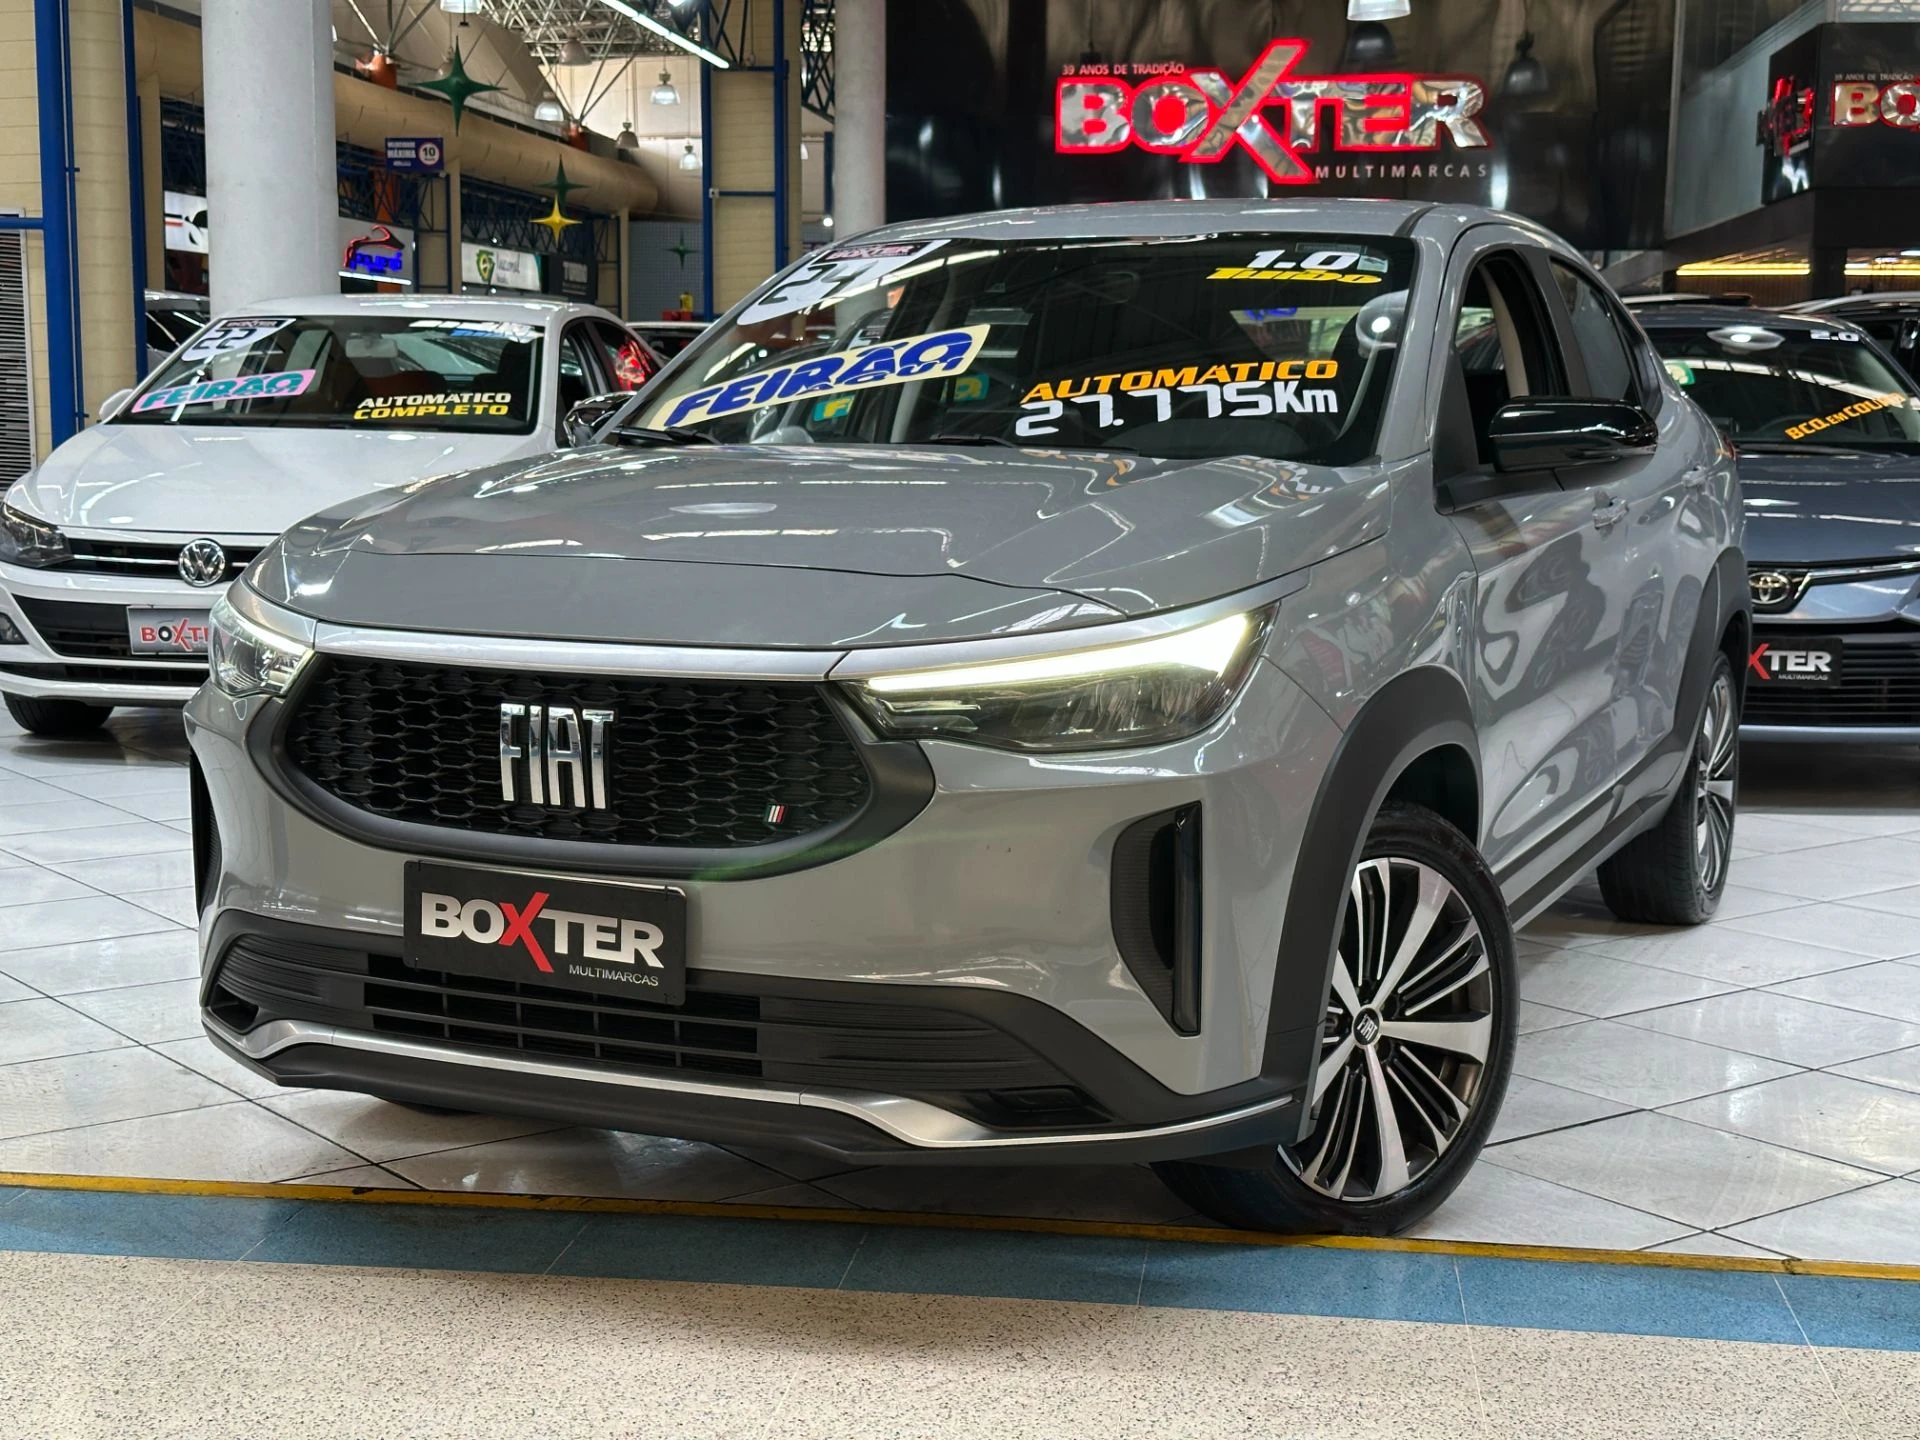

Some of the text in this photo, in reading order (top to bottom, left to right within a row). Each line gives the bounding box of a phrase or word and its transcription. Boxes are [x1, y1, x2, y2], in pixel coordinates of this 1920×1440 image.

[1062, 61, 1185, 76] 39 ANOS DE TRADIÇÃO
[1055, 37, 1495, 184] BOXTER
[1831, 80, 1920, 130] BO
[422, 146, 437, 157] 10
[1315, 164, 1488, 179] MULTIMARCAS
[1246, 249, 1361, 271] 1.0
[191, 328, 258, 350] 22
[1810, 329, 1859, 342] 2.0
[140, 372, 304, 409] FEIRÃO
[664, 332, 974, 427] FEIRÃO
[356, 392, 513, 409] AUTOMATICO
[353, 404, 510, 420] COMPLETO
[500, 702, 615, 810] FIAT
[420, 891, 666, 974] BOXTER
[568, 963, 660, 988] MULTIMARCAS
